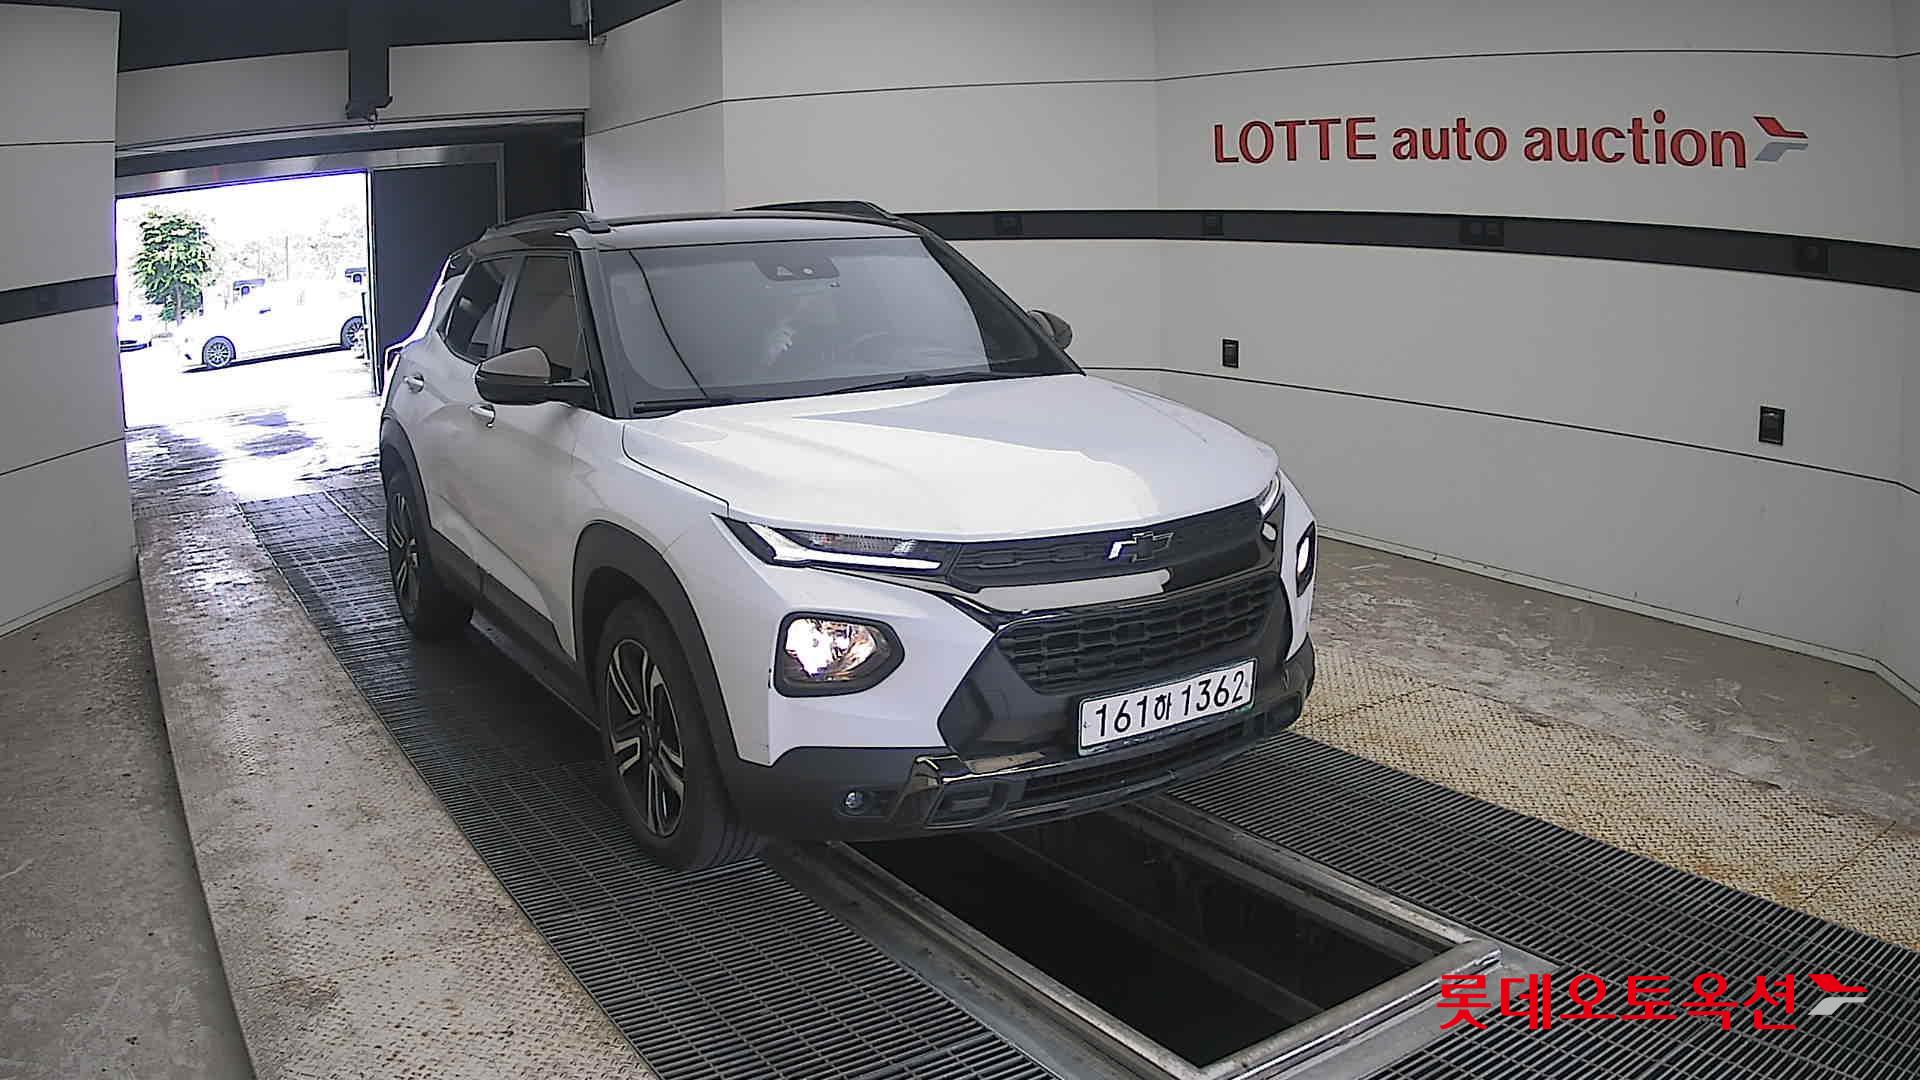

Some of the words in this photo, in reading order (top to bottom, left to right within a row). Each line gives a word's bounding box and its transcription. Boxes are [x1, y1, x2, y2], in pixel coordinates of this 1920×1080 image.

[1214, 117, 1377, 164] LOTTE
[1392, 117, 1508, 162] auto
[1524, 109, 1747, 169] auction
[1095, 692, 1172, 737] 161하
[1181, 670, 1245, 717] 1362
